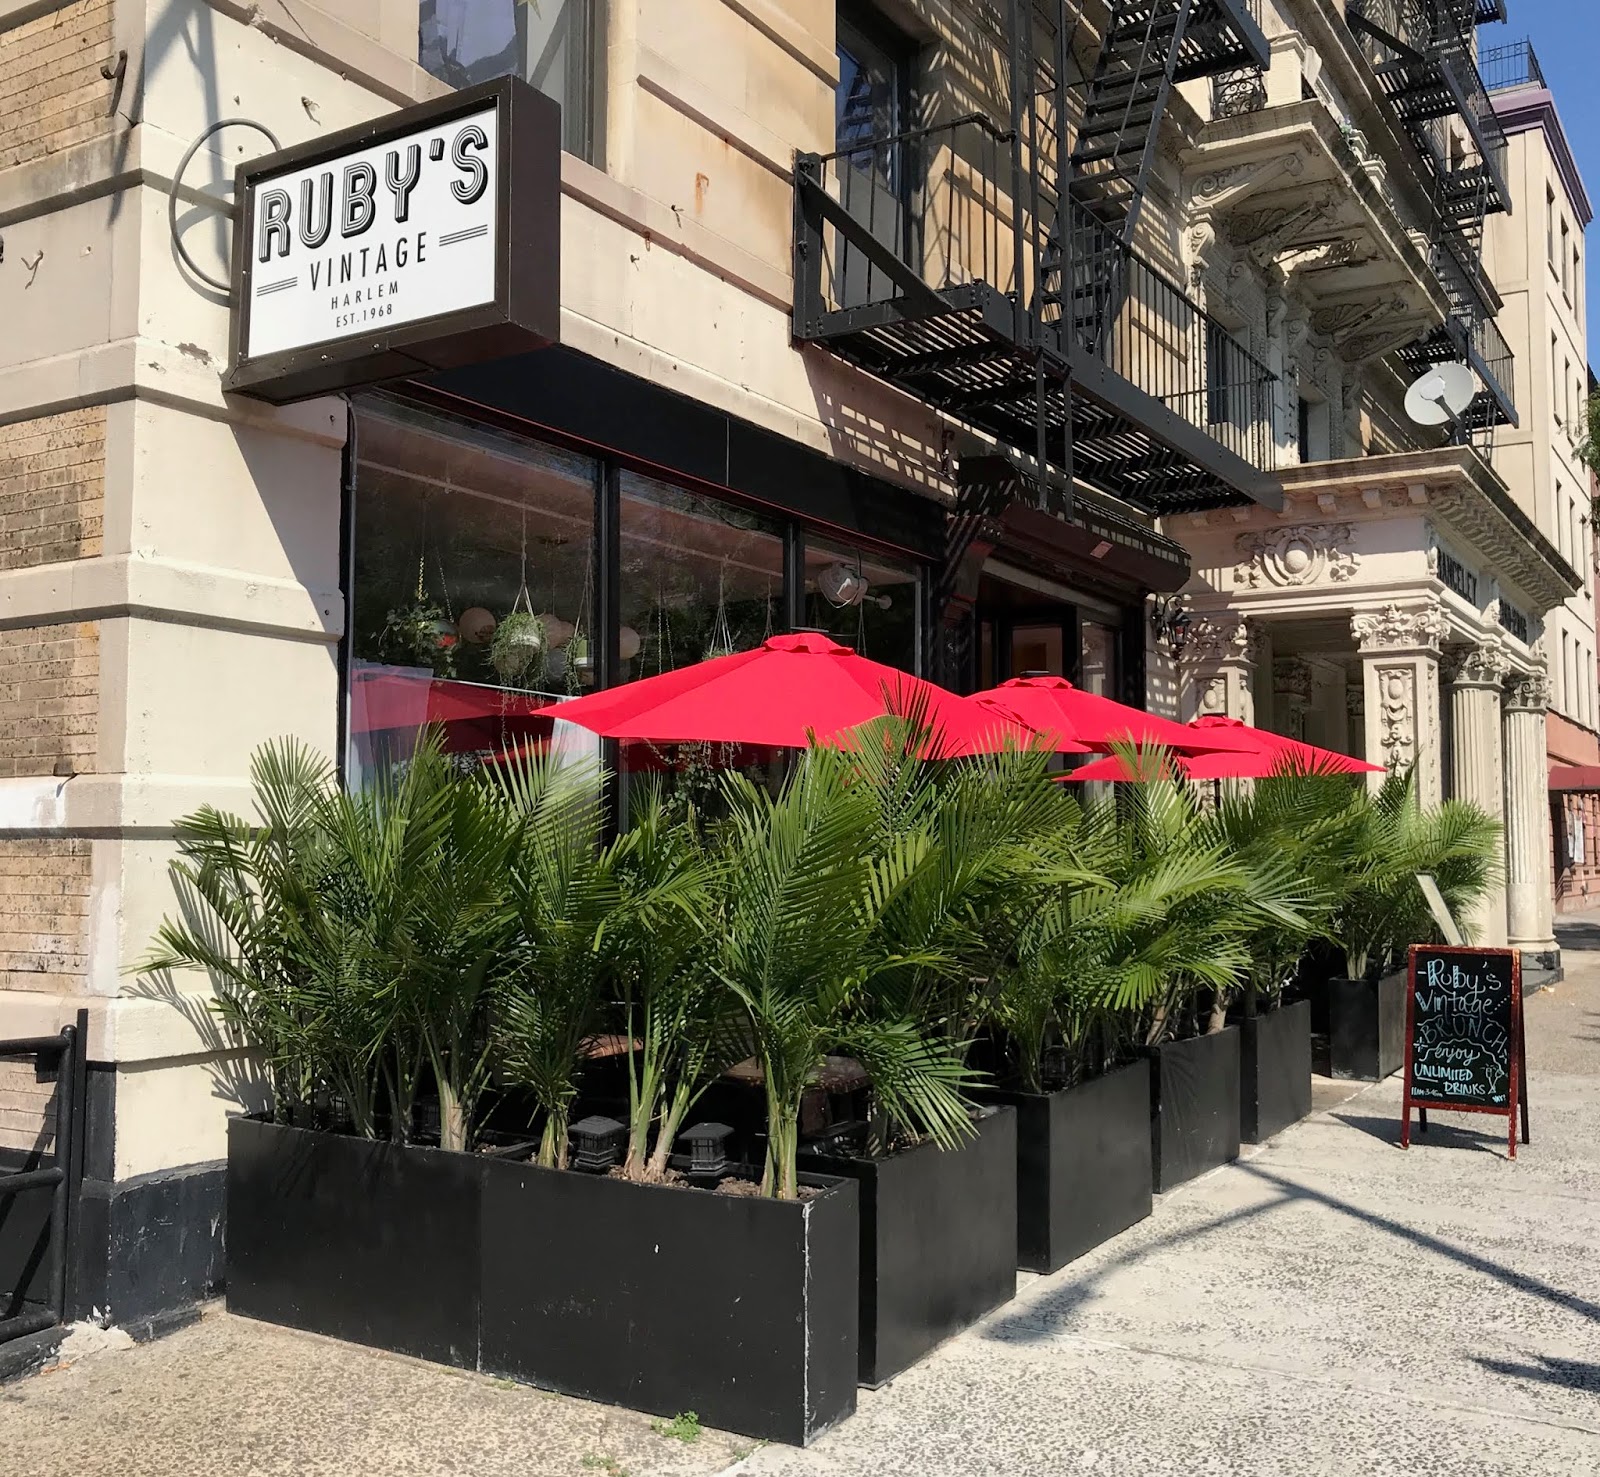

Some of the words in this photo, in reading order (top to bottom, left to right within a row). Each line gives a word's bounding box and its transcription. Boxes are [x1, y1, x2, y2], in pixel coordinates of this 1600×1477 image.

[258, 124, 489, 263] RUBY'S
[310, 231, 427, 291] VINTAGE
[331, 280, 398, 310] HARLEM
[1415, 989, 1494, 1020] Vintage
[1420, 1016, 1508, 1053] BRUNCH
[1434, 1044, 1480, 1066] enjoy
[1414, 1062, 1473, 1081] UNLIMITED
[1443, 1081, 1486, 1095] DRINKS
